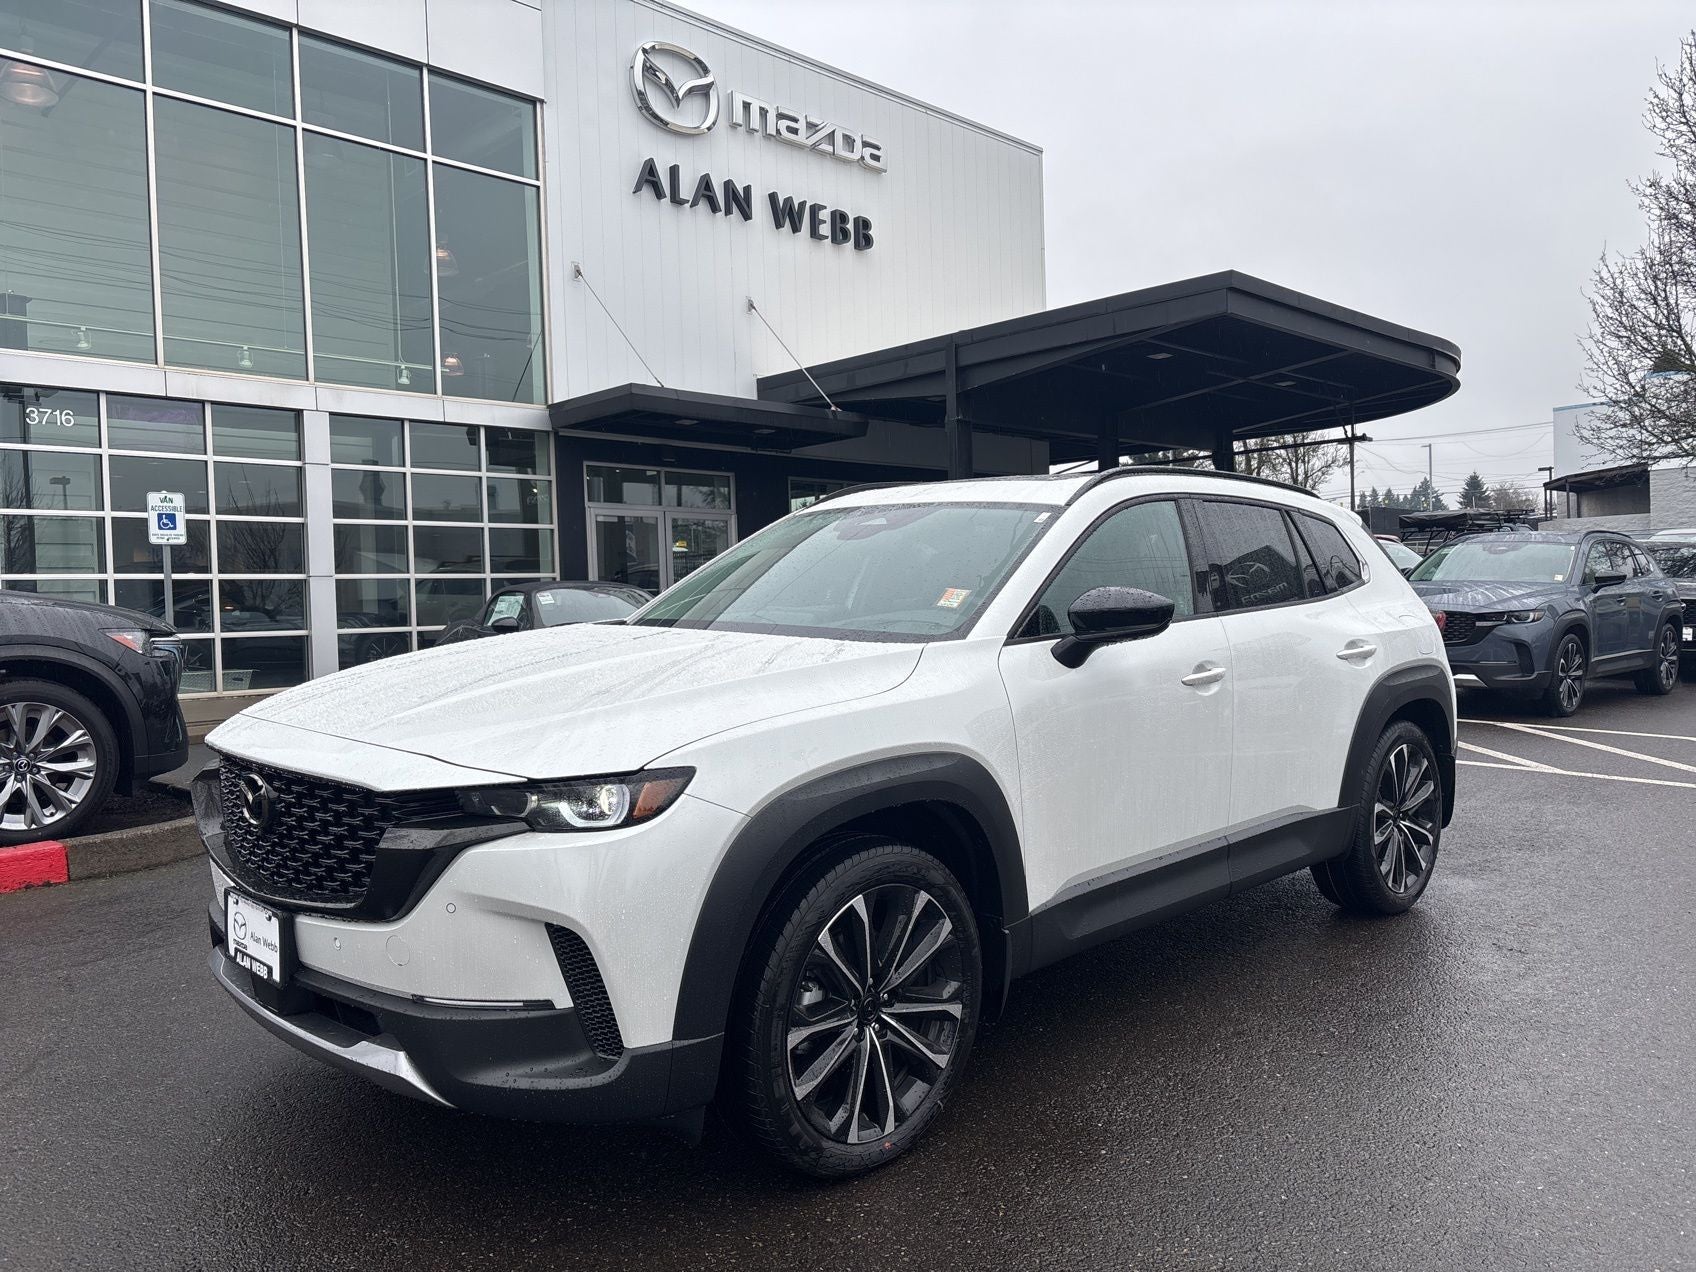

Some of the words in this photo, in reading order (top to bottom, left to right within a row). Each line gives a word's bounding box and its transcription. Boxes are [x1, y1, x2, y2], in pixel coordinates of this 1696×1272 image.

[728, 90, 887, 173] mazda
[632, 157, 753, 222] ALAN
[768, 191, 874, 251] WEBB
[25, 407, 75, 427] 3716
[250, 931, 262, 945] Alan
[262, 936, 278, 953] Webb
